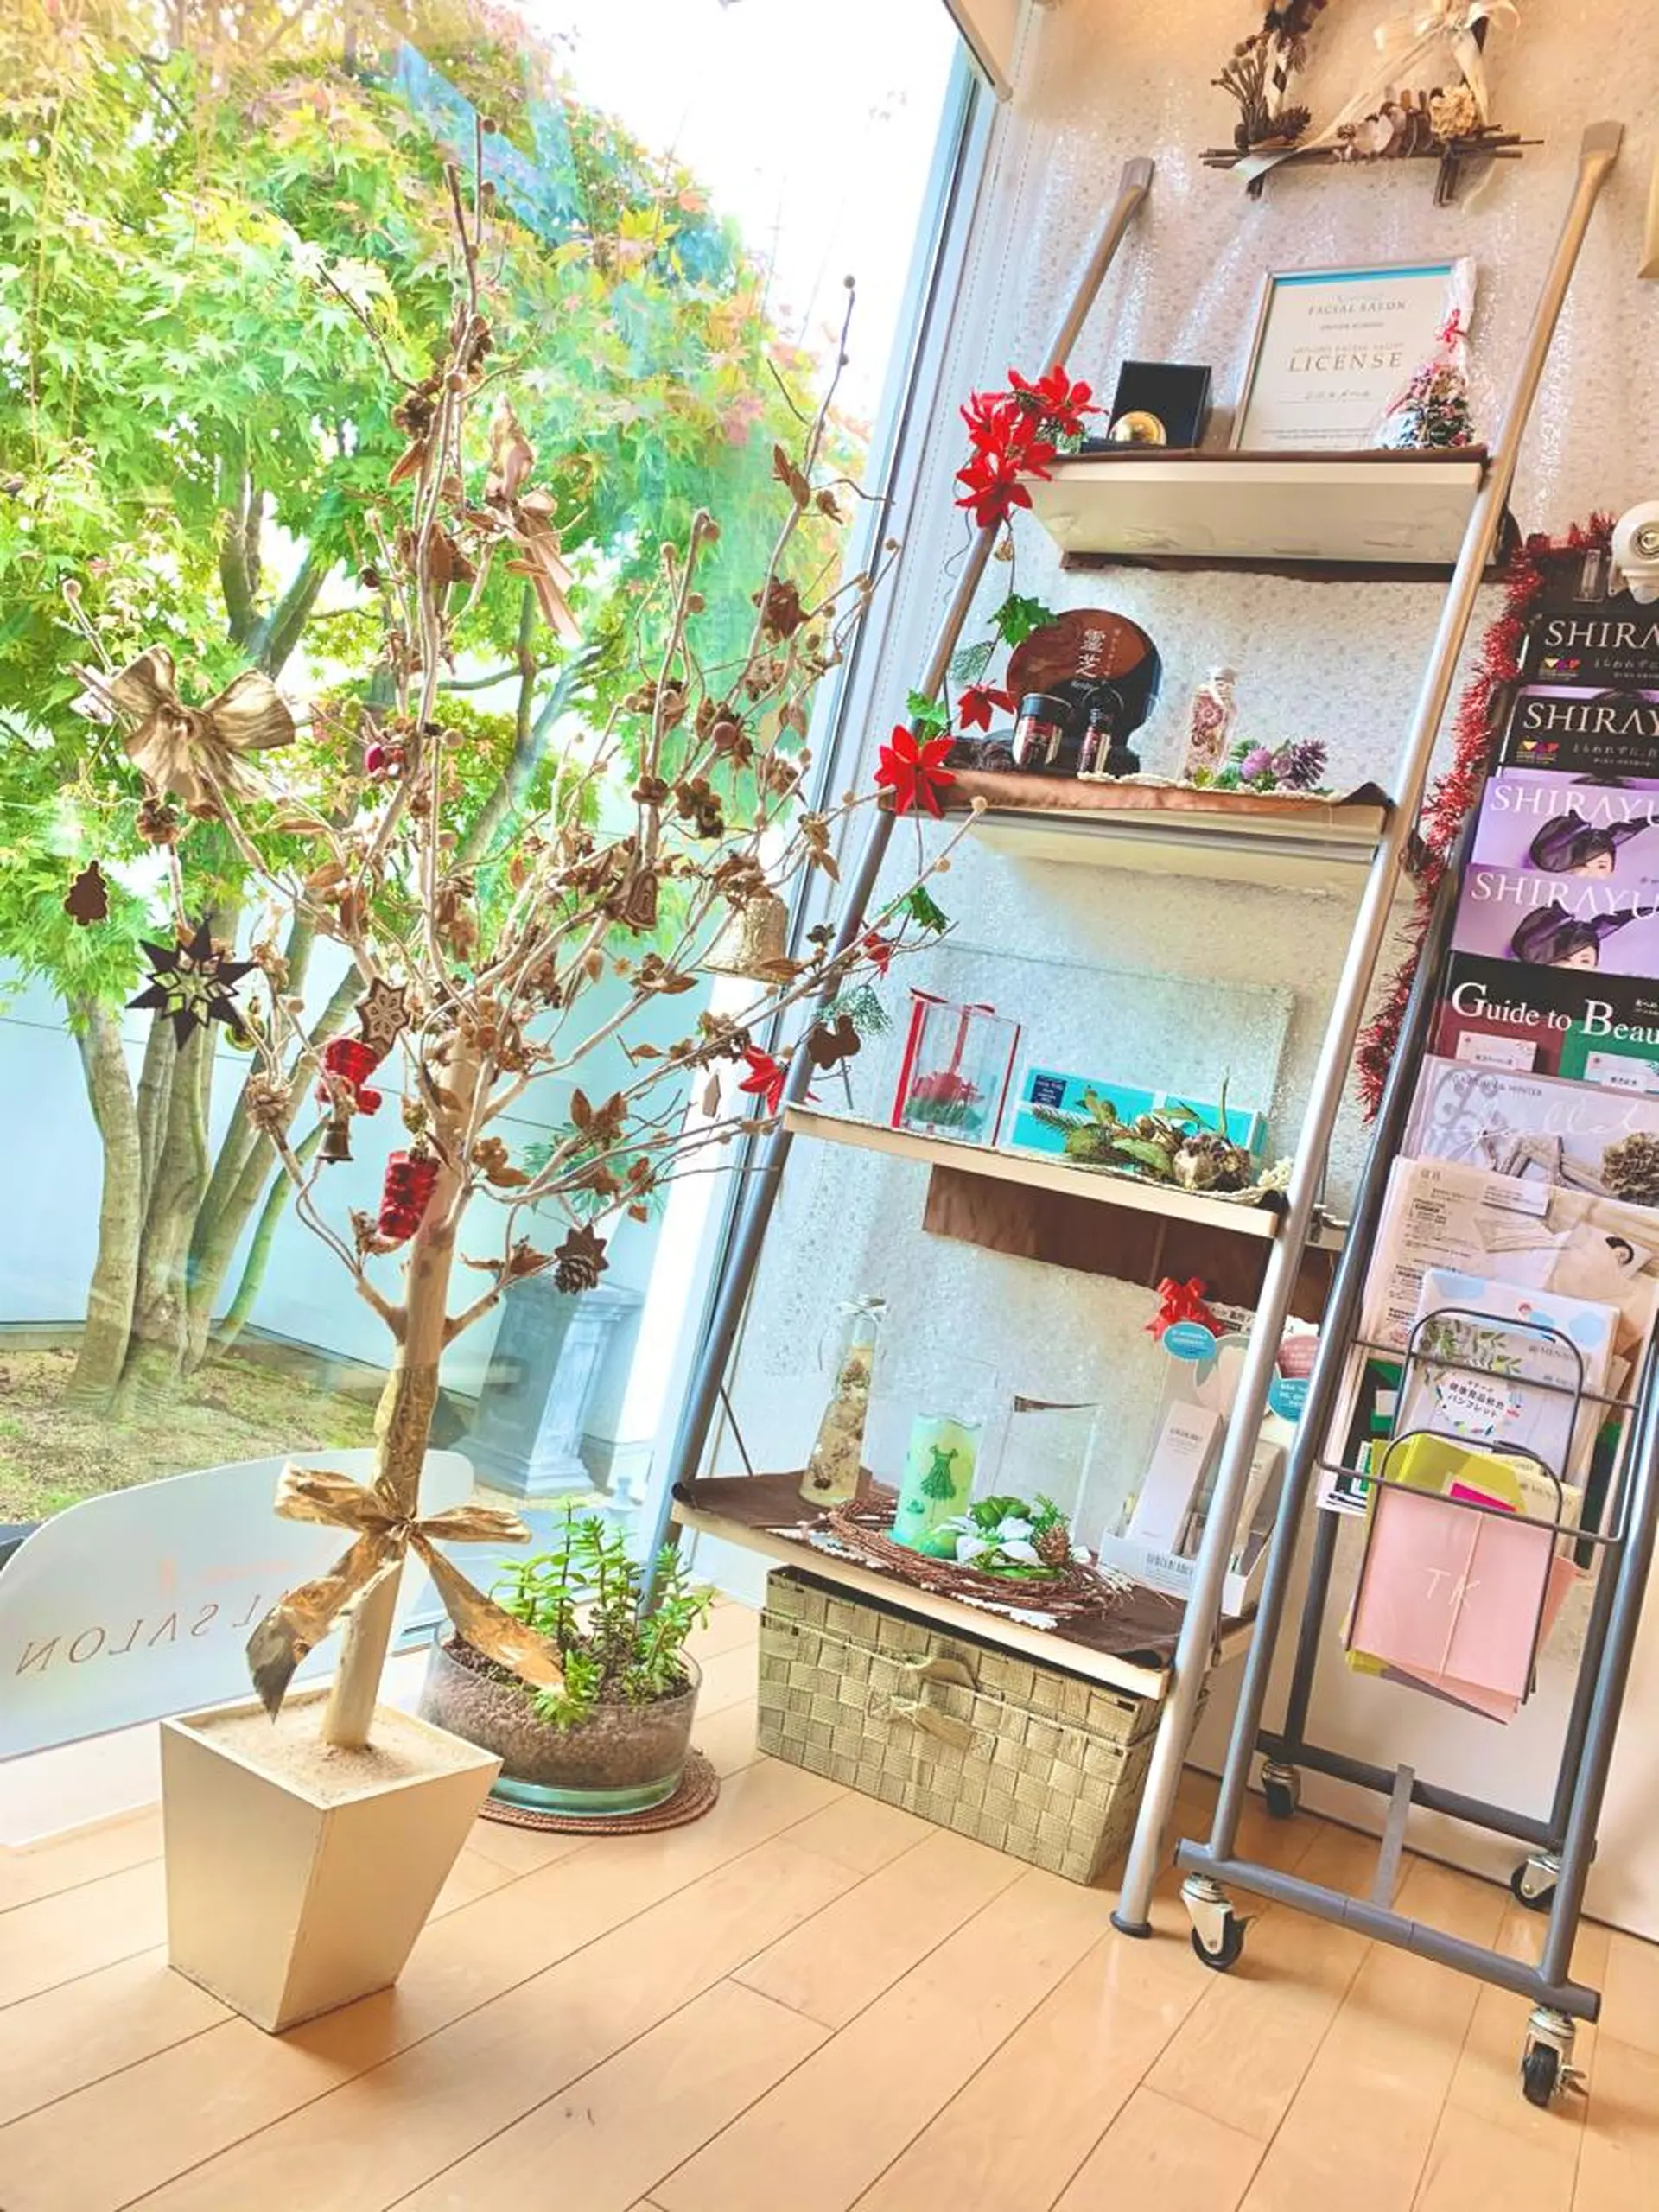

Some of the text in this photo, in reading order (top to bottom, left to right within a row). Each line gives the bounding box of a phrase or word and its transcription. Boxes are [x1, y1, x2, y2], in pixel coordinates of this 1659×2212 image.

[1288, 351, 1404, 373] LICENSE
[1452, 981, 1541, 1027] Guide
[1548, 1008, 1573, 1032] to
